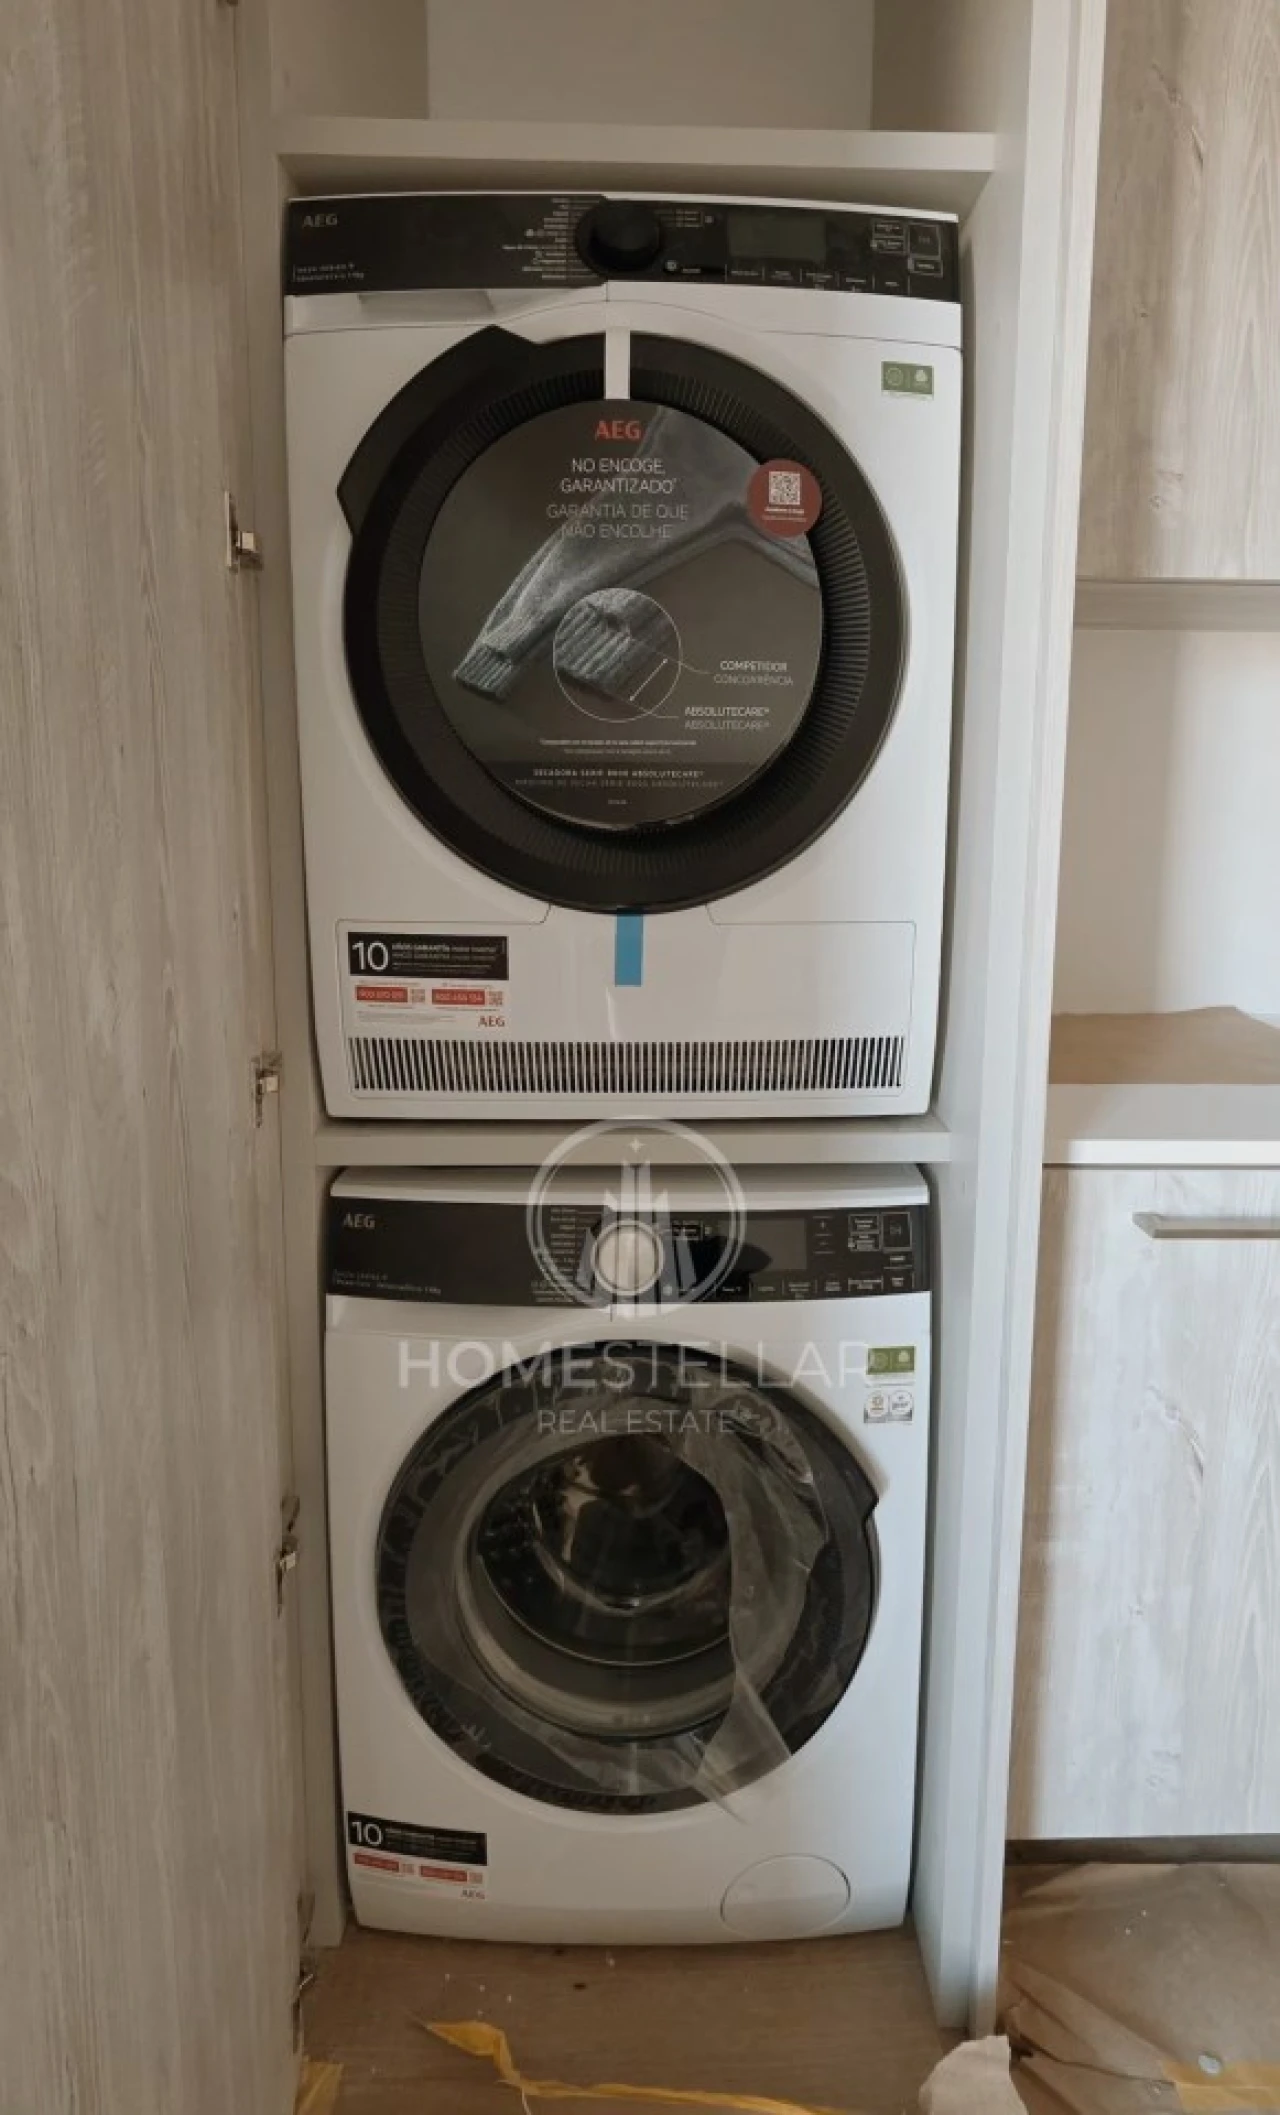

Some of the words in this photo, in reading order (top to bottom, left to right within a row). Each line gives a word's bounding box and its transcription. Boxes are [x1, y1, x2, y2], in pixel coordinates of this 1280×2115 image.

[302, 213, 338, 228] AEG
[594, 420, 641, 440] AEG
[572, 458, 596, 473] NO
[546, 503, 627, 519] GARANTIA
[631, 504, 652, 519] DE
[656, 504, 690, 521] QUE
[601, 524, 673, 539] ENCOLHE
[720, 660, 788, 673] COMPETIDOR
[352, 941, 389, 971] 10
[478, 1015, 505, 1028] AEG
[343, 1212, 376, 1229] AEG
[351, 1821, 384, 1846] 10
